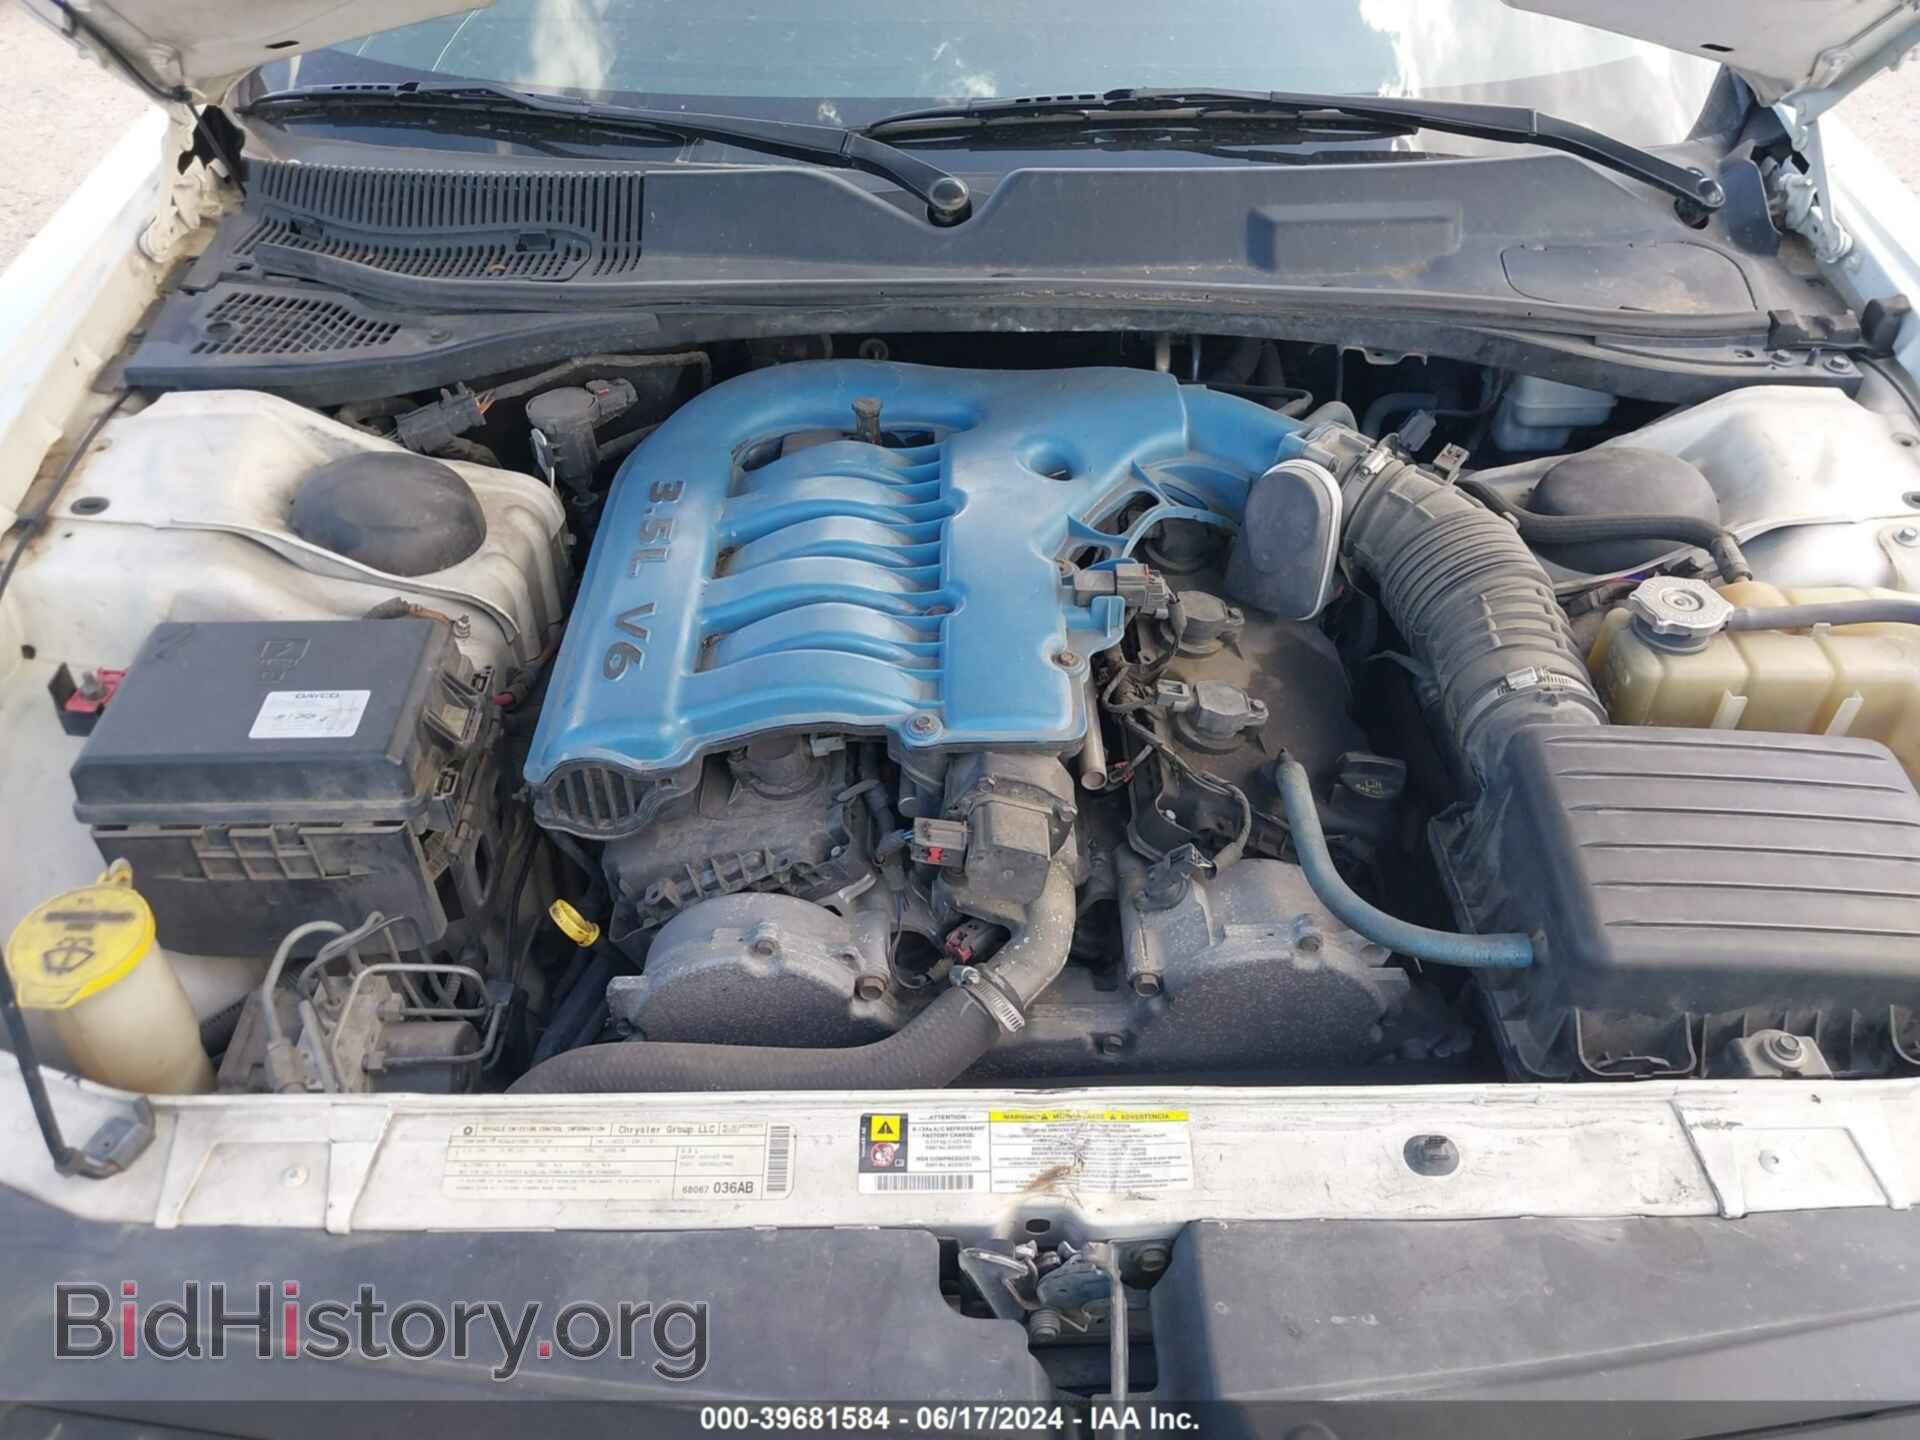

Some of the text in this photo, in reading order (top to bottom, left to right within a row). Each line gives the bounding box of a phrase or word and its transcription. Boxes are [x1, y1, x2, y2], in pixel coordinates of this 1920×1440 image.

[602, 479, 687, 682] 3.5L V6
[618, 1124, 716, 1135] Chrysler Group LLC
[712, 1181, 755, 1195] 036AB
